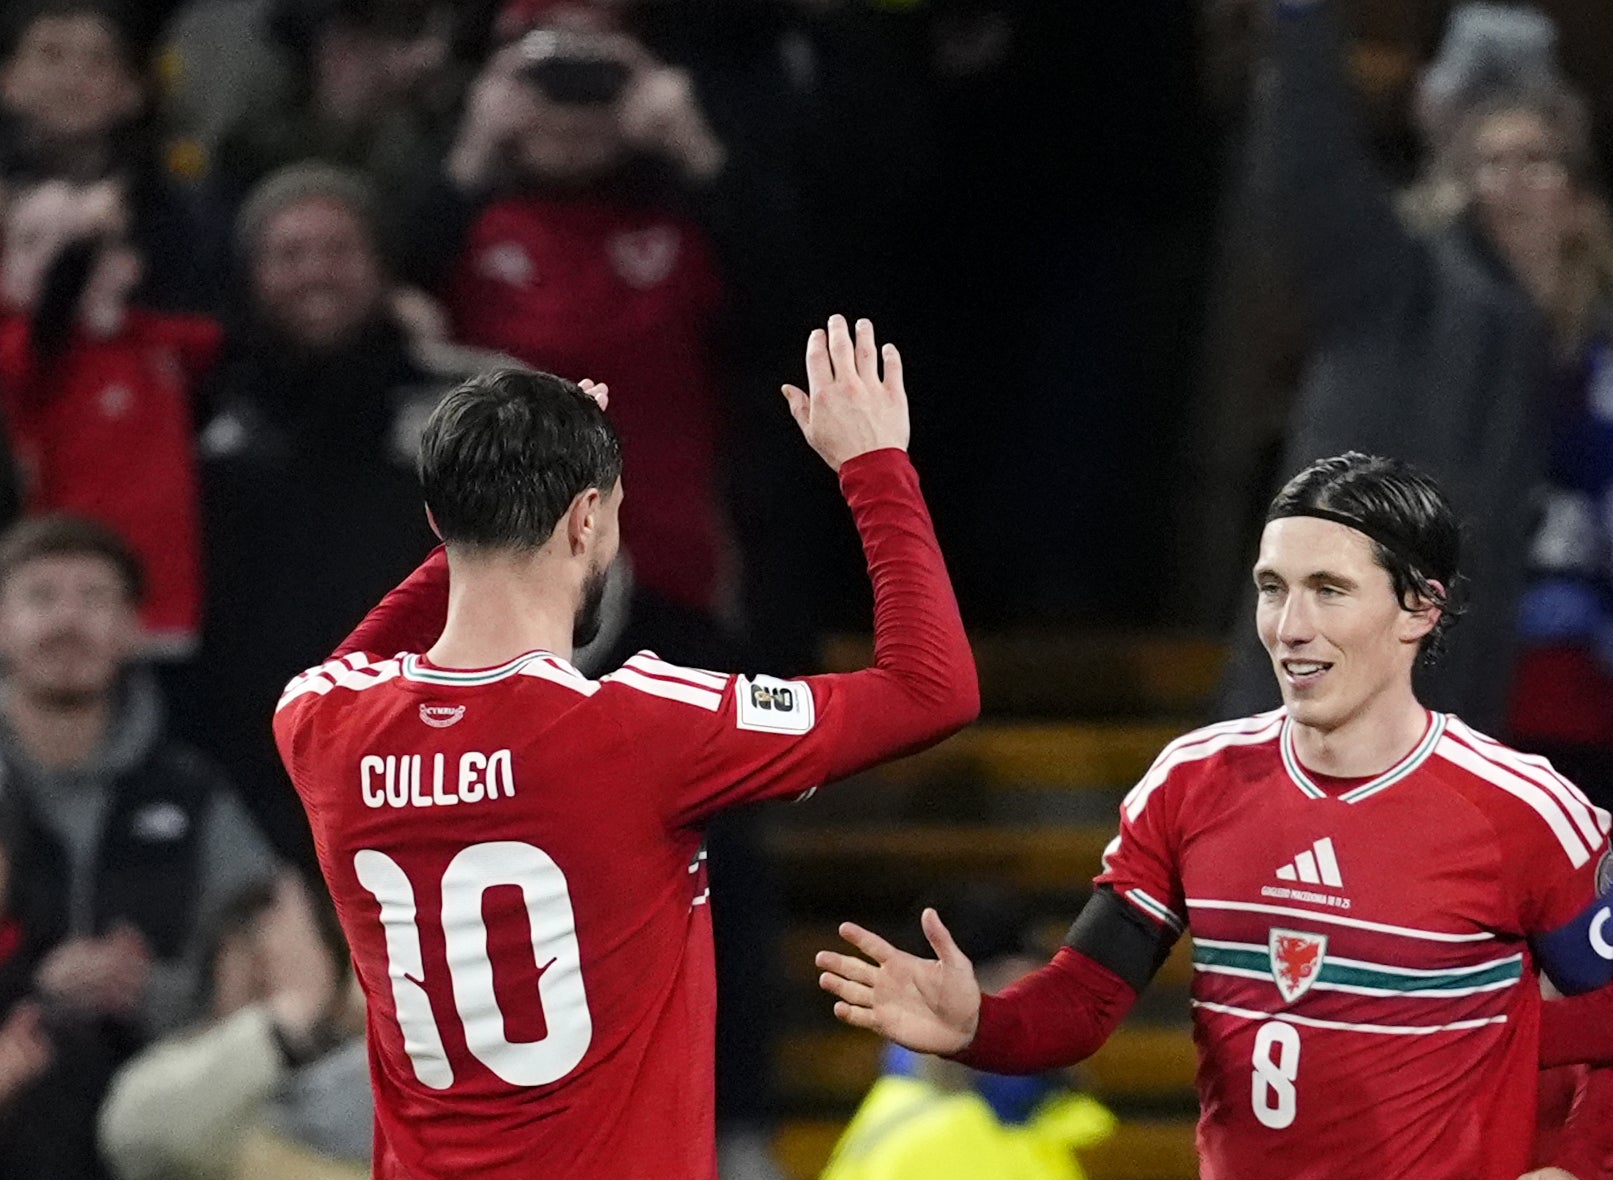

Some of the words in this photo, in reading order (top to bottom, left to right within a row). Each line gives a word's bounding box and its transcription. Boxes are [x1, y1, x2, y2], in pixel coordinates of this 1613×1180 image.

[360, 748, 516, 808] CULLEN
[352, 840, 593, 1090] 10
[1251, 1020, 1301, 1129] 8
